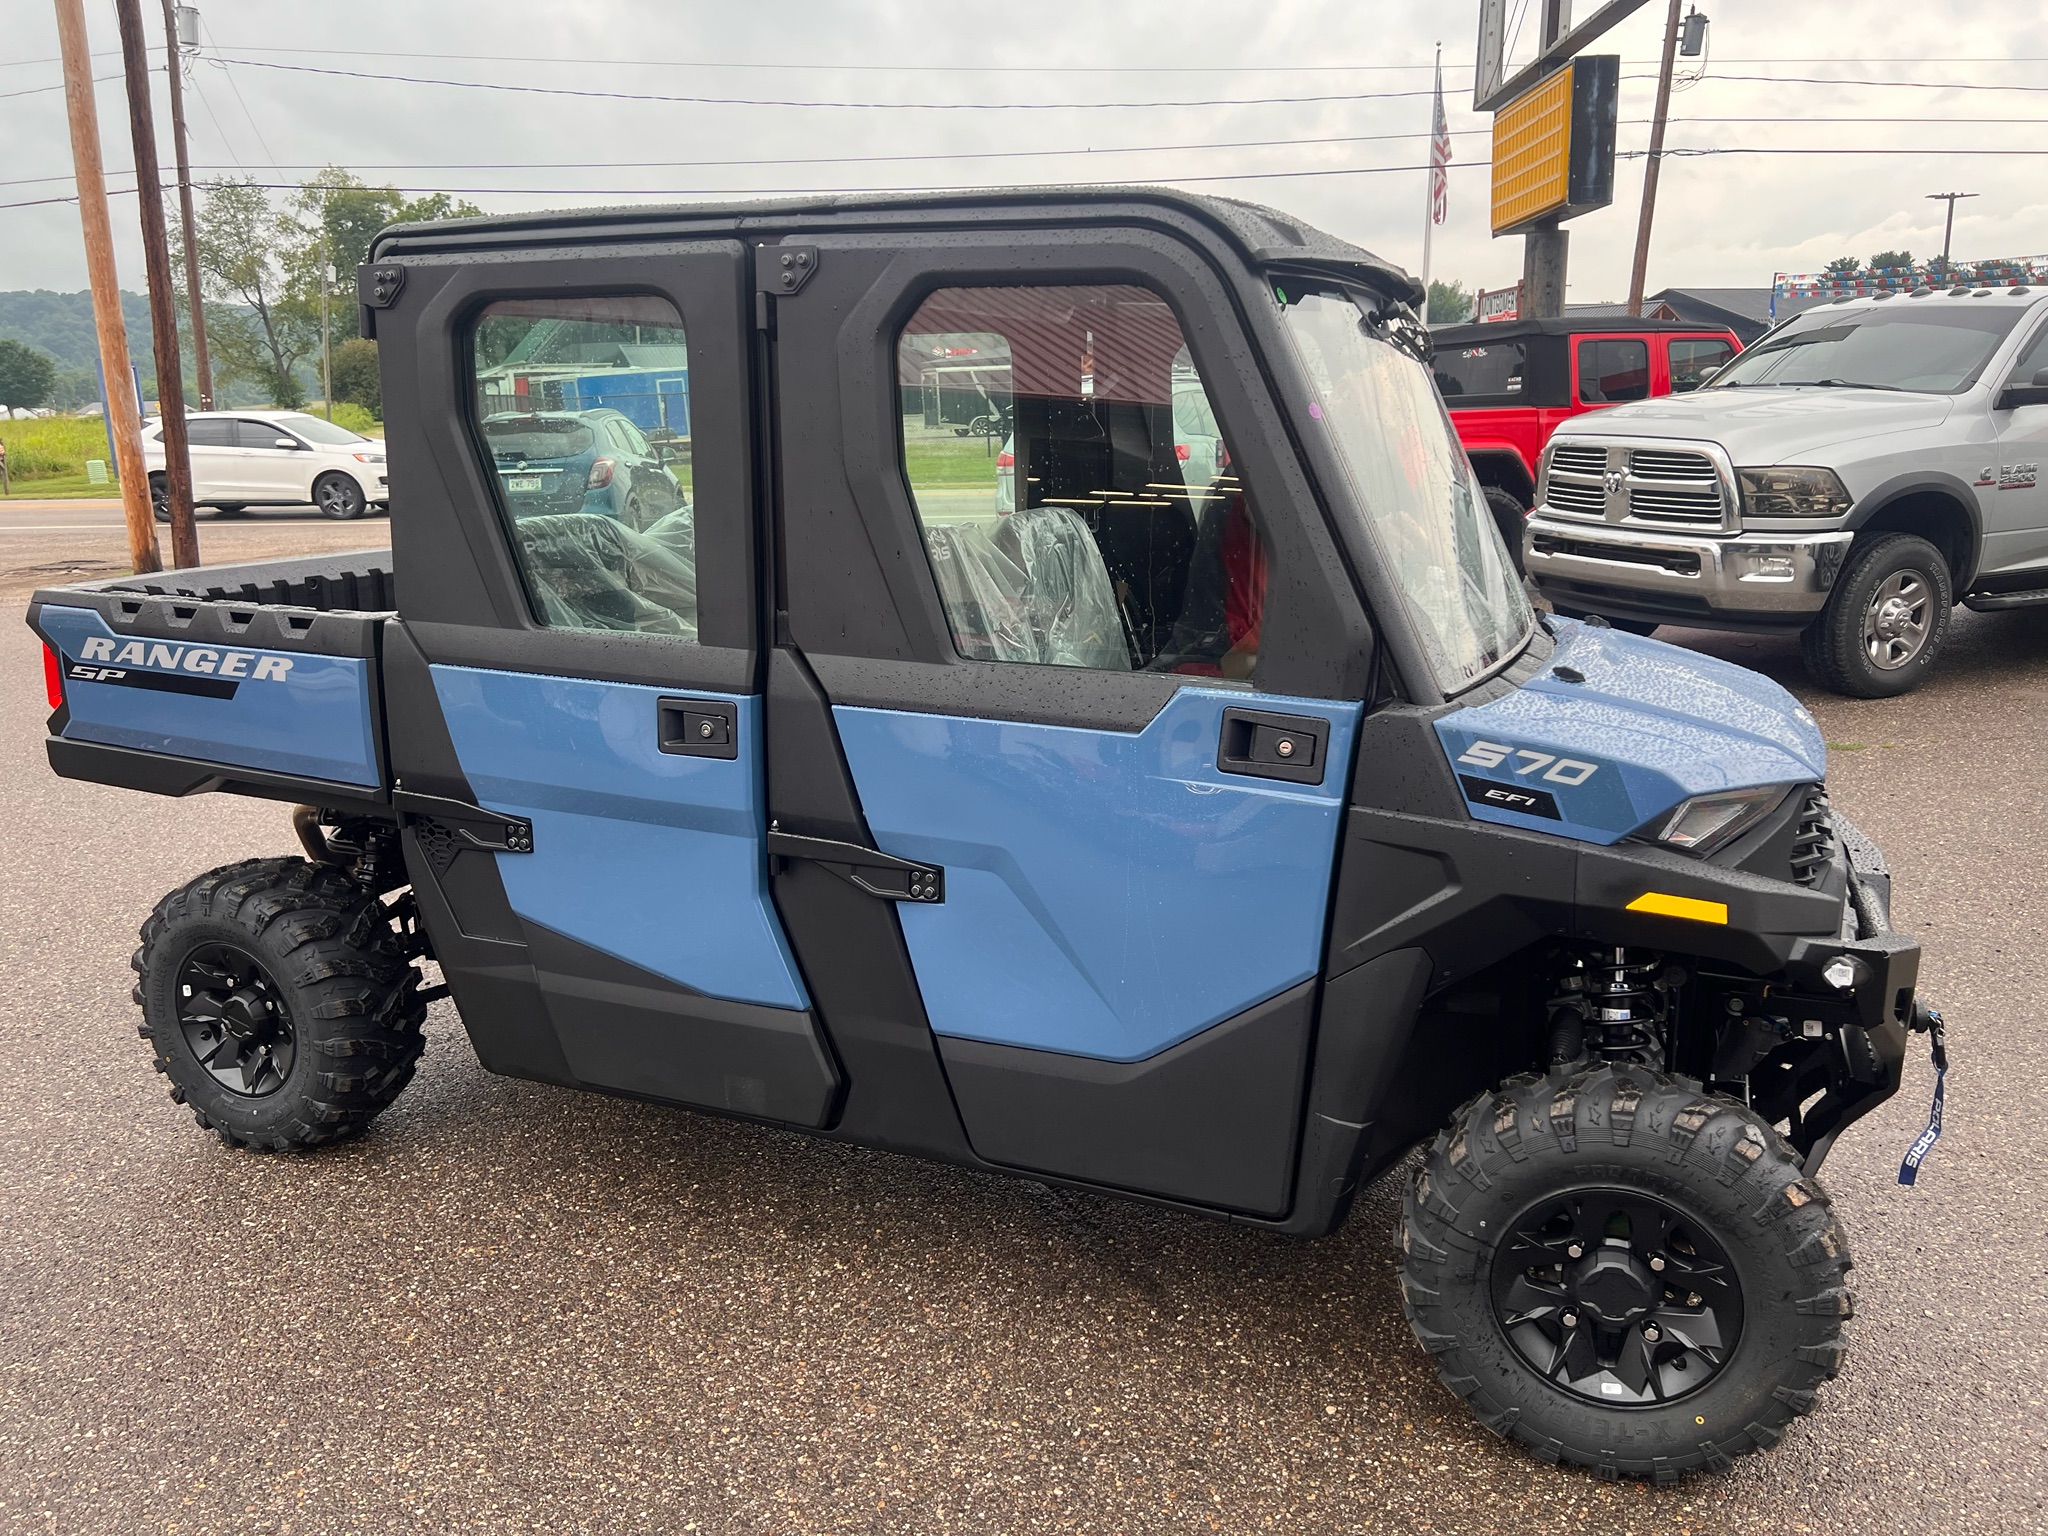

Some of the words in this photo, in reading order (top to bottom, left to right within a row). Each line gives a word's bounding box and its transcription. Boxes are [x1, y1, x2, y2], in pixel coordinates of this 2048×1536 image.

[2000, 473, 2036, 484] 2500
[69, 666, 127, 681] SP
[79, 636, 294, 683] RANGER
[1457, 740, 1599, 786] 570
[1484, 789, 1537, 806] EFI
[1905, 1097, 1943, 1168] POLARIS
